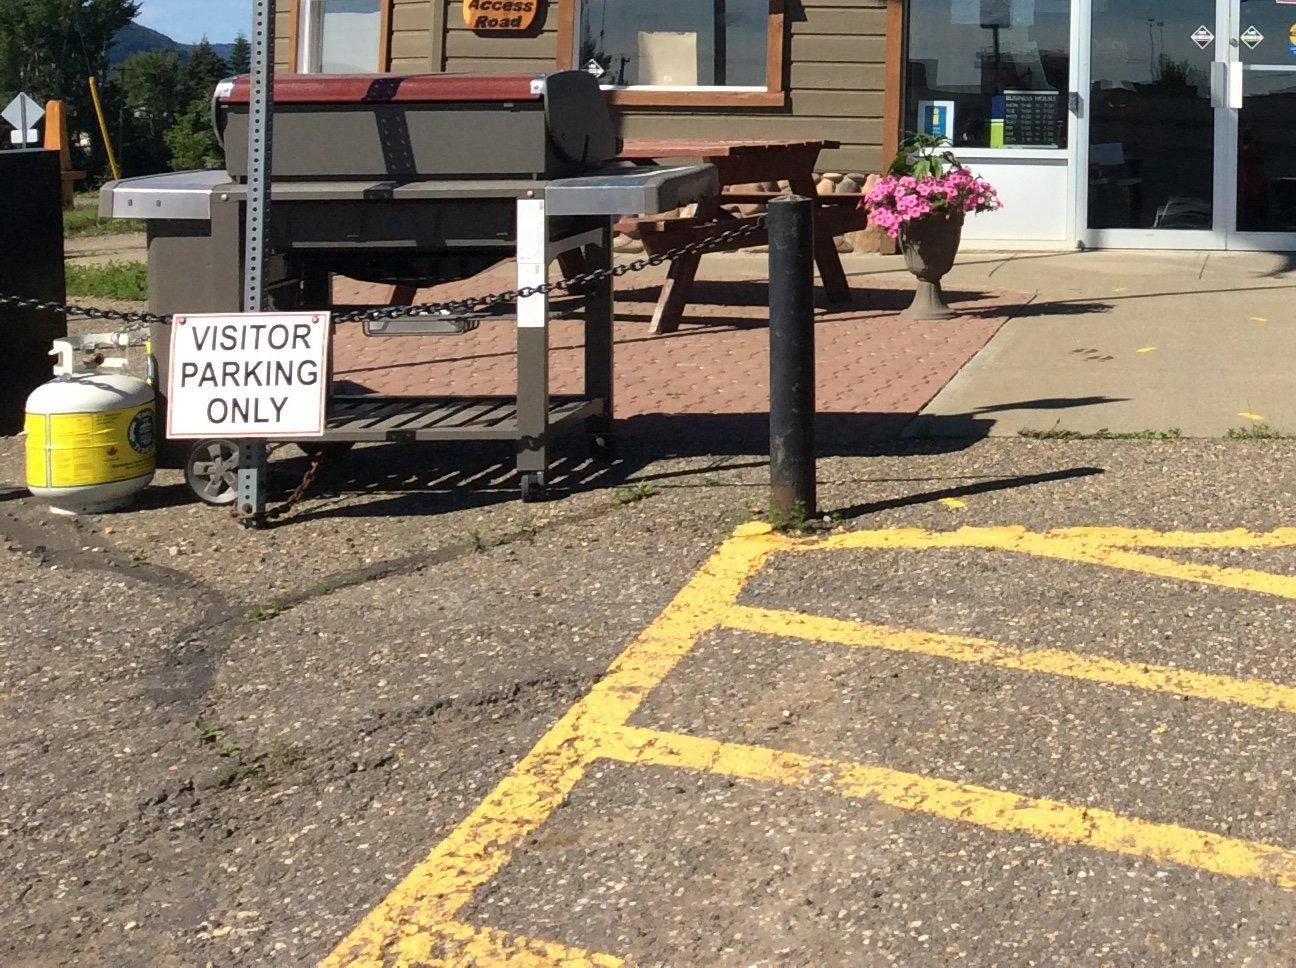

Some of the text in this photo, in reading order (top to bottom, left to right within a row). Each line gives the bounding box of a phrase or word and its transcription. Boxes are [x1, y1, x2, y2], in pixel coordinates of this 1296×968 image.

[474, 15, 522, 28] Road
[192, 323, 311, 351] VISITOR
[180, 359, 318, 387] PARKING
[206, 397, 289, 424] ONLY
